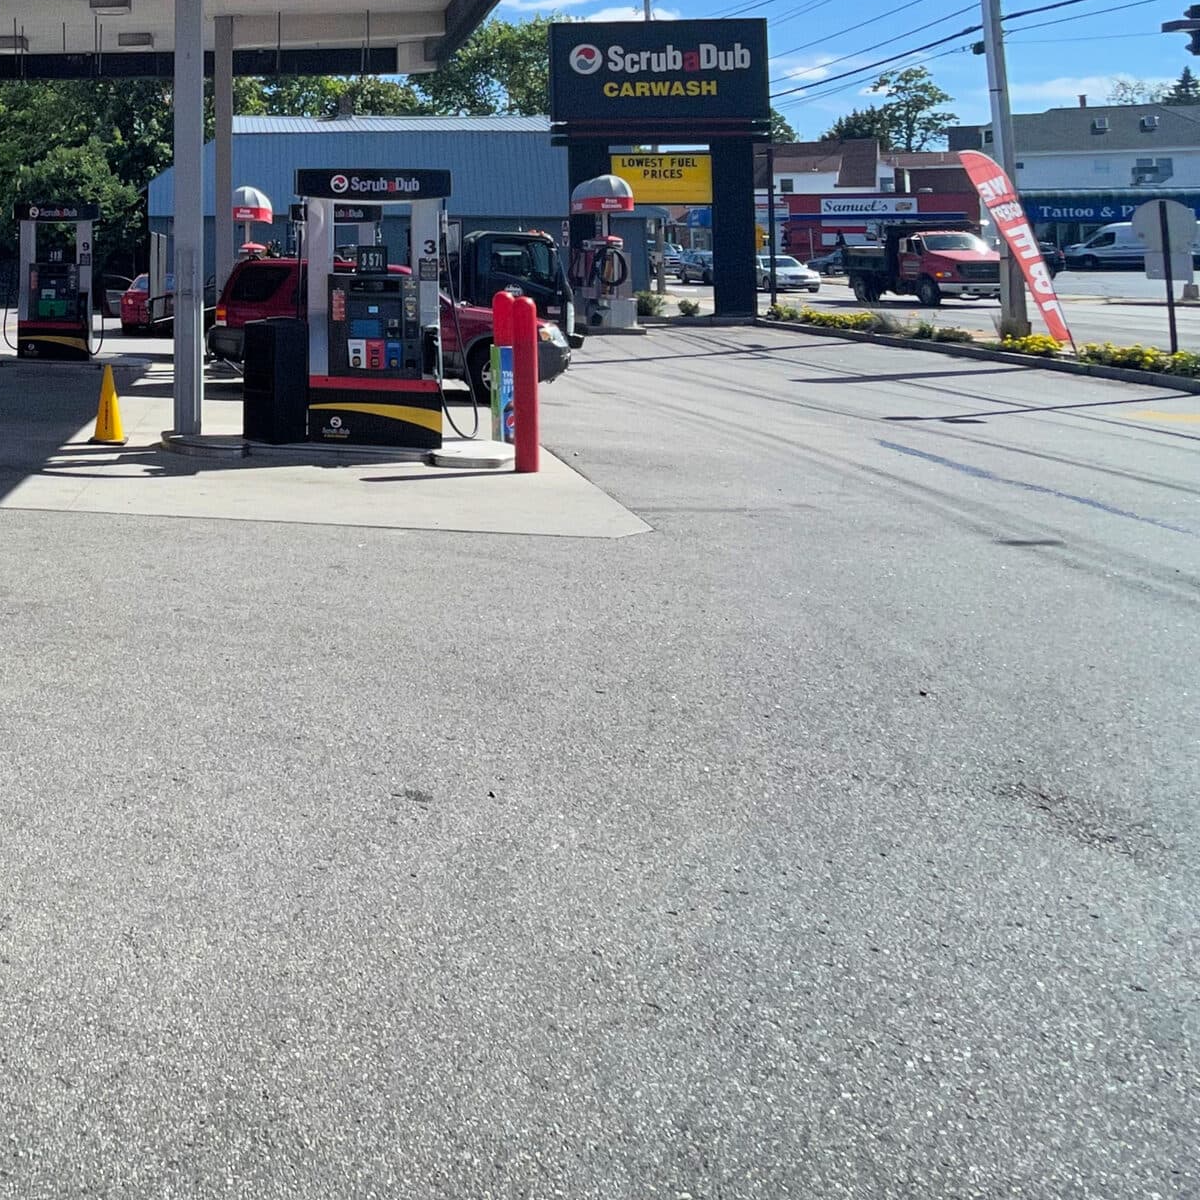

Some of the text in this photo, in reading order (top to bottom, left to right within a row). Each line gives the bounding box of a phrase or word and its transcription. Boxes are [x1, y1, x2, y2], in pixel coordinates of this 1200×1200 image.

[603, 80, 717, 98] CARWASH
[621, 157, 698, 168] LOWEST FUEL
[643, 168, 683, 179] PRICES
[823, 200, 889, 213] Samuel's
[1039, 205, 1095, 218] Tattoo
[1100, 206, 1114, 218] &
[82, 242, 90, 251] 9
[423, 239, 436, 255] 3
